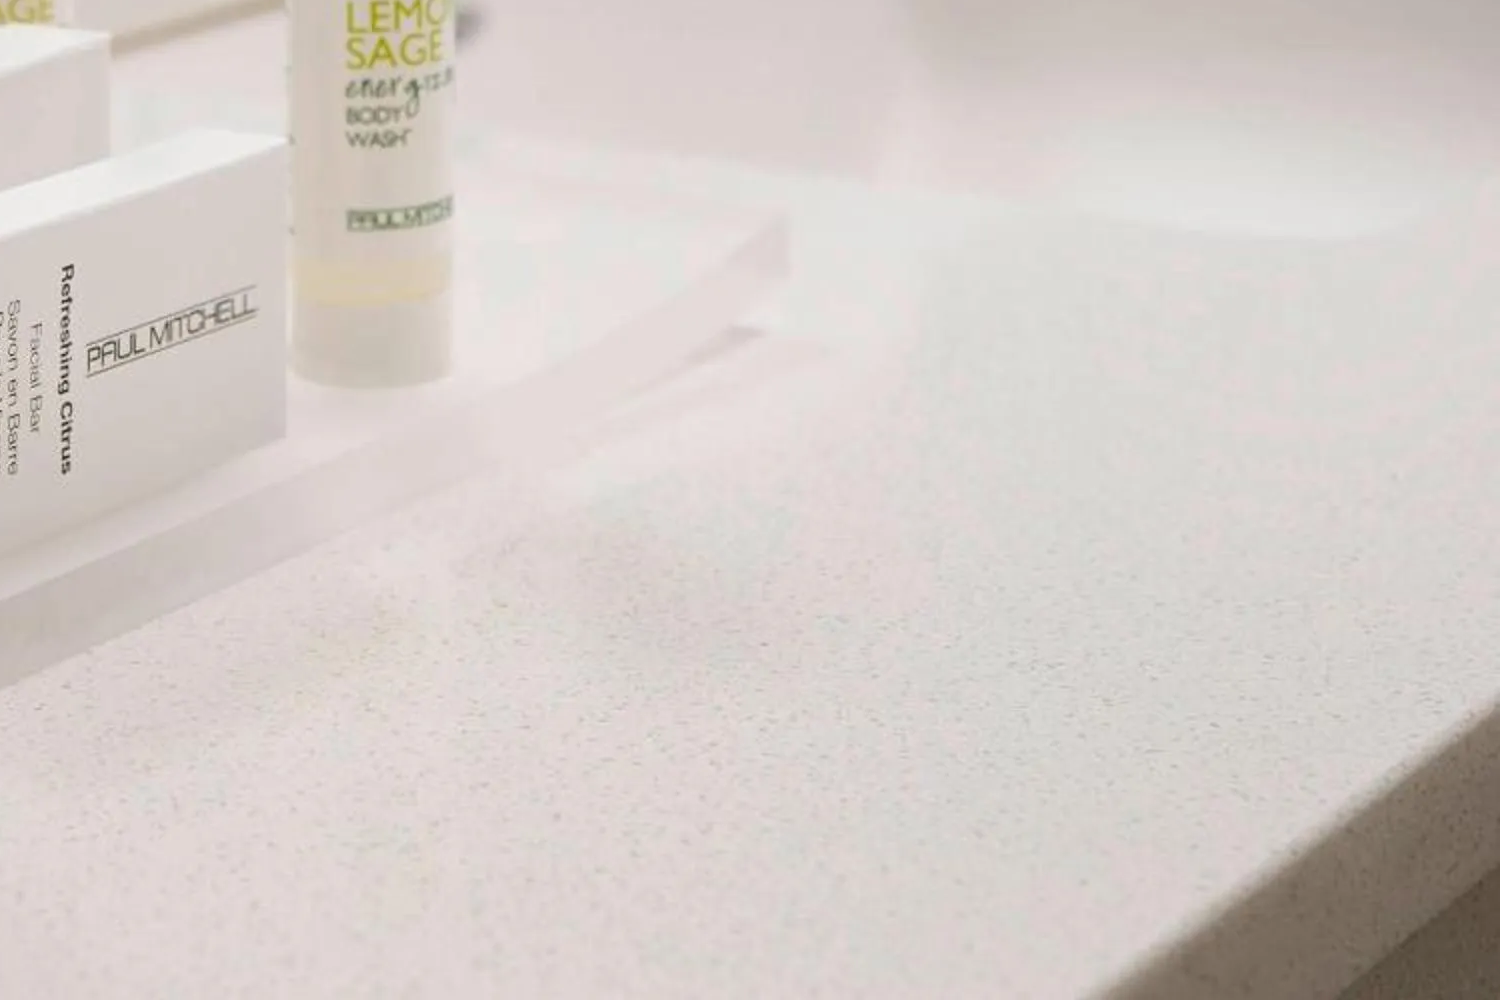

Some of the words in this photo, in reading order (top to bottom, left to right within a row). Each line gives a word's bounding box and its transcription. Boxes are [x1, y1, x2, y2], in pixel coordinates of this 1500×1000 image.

[345, 29, 443, 71] SAGE
[346, 105, 402, 125] BODY
[7, 298, 21, 372] Savon
[27, 321, 44, 390] Facial
[56, 263, 75, 396] Refreshing
[86, 332, 146, 373] PAUL
[149, 293, 259, 350] MITCHELL
[7, 378, 19, 409] en
[29, 394, 44, 434] Bar
[7, 412, 21, 476] Barre
[59, 400, 74, 476] Citrus
